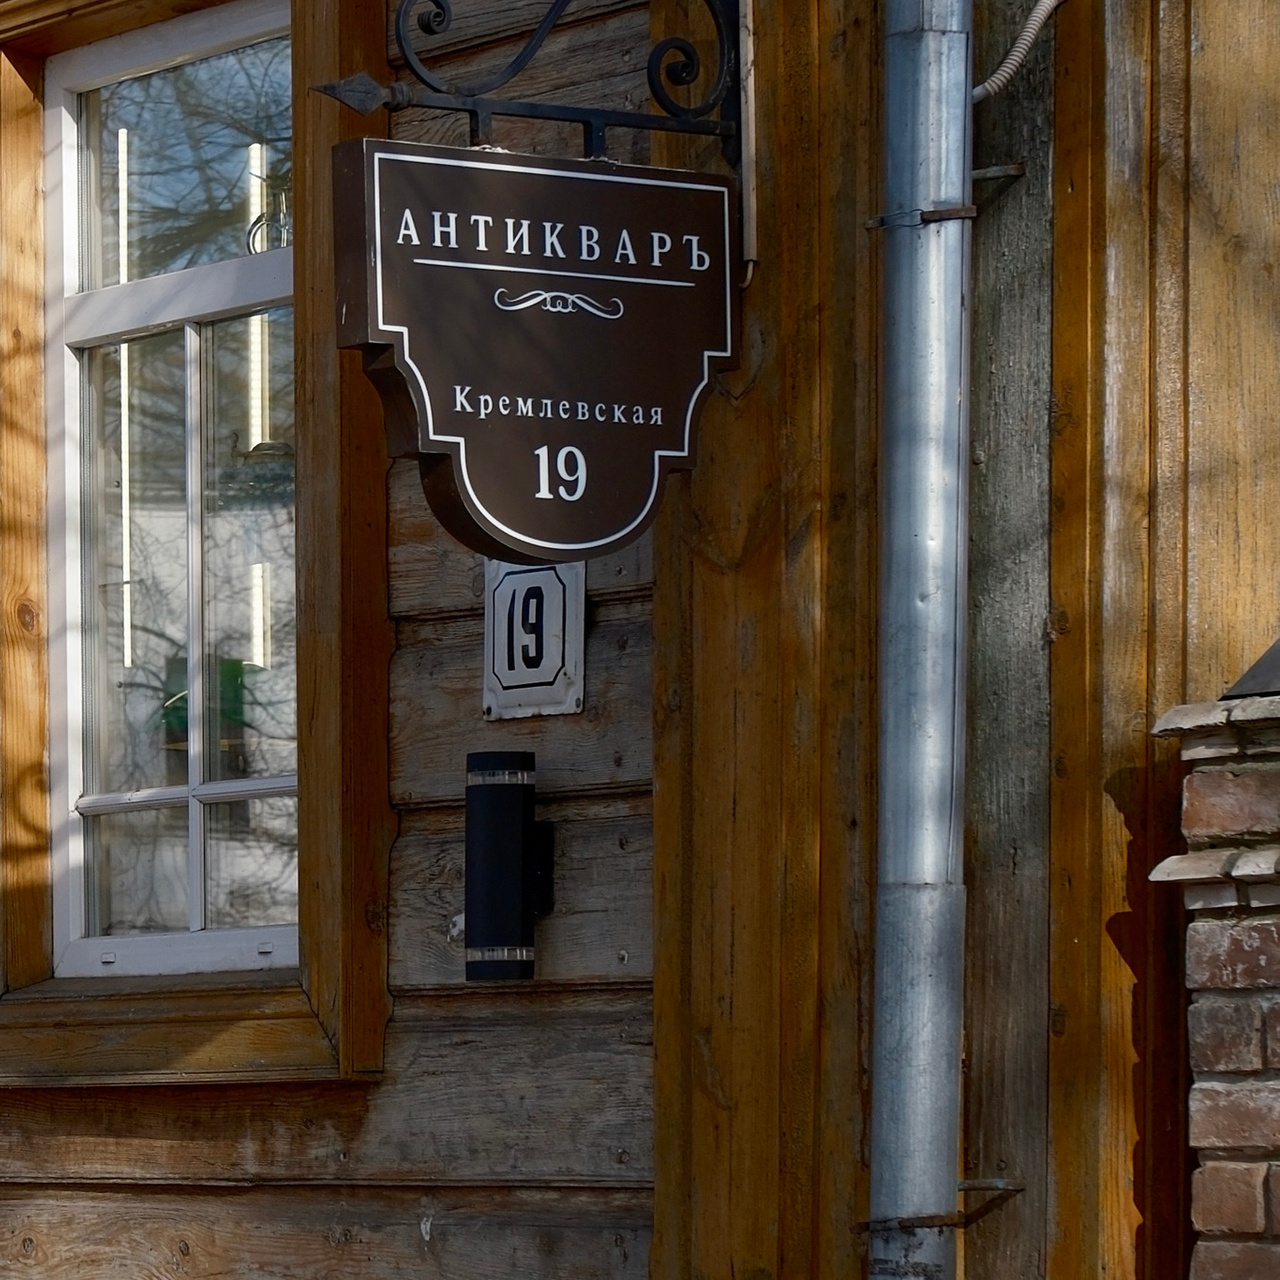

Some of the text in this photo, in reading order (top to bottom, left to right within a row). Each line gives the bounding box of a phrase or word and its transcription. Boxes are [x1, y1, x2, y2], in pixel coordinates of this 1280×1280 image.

[396, 207, 711, 271] АНТИКВАРЪ
[453, 385, 664, 425] Кремлевская
[533, 445, 588, 502] 19
[507, 586, 545, 671] 19
